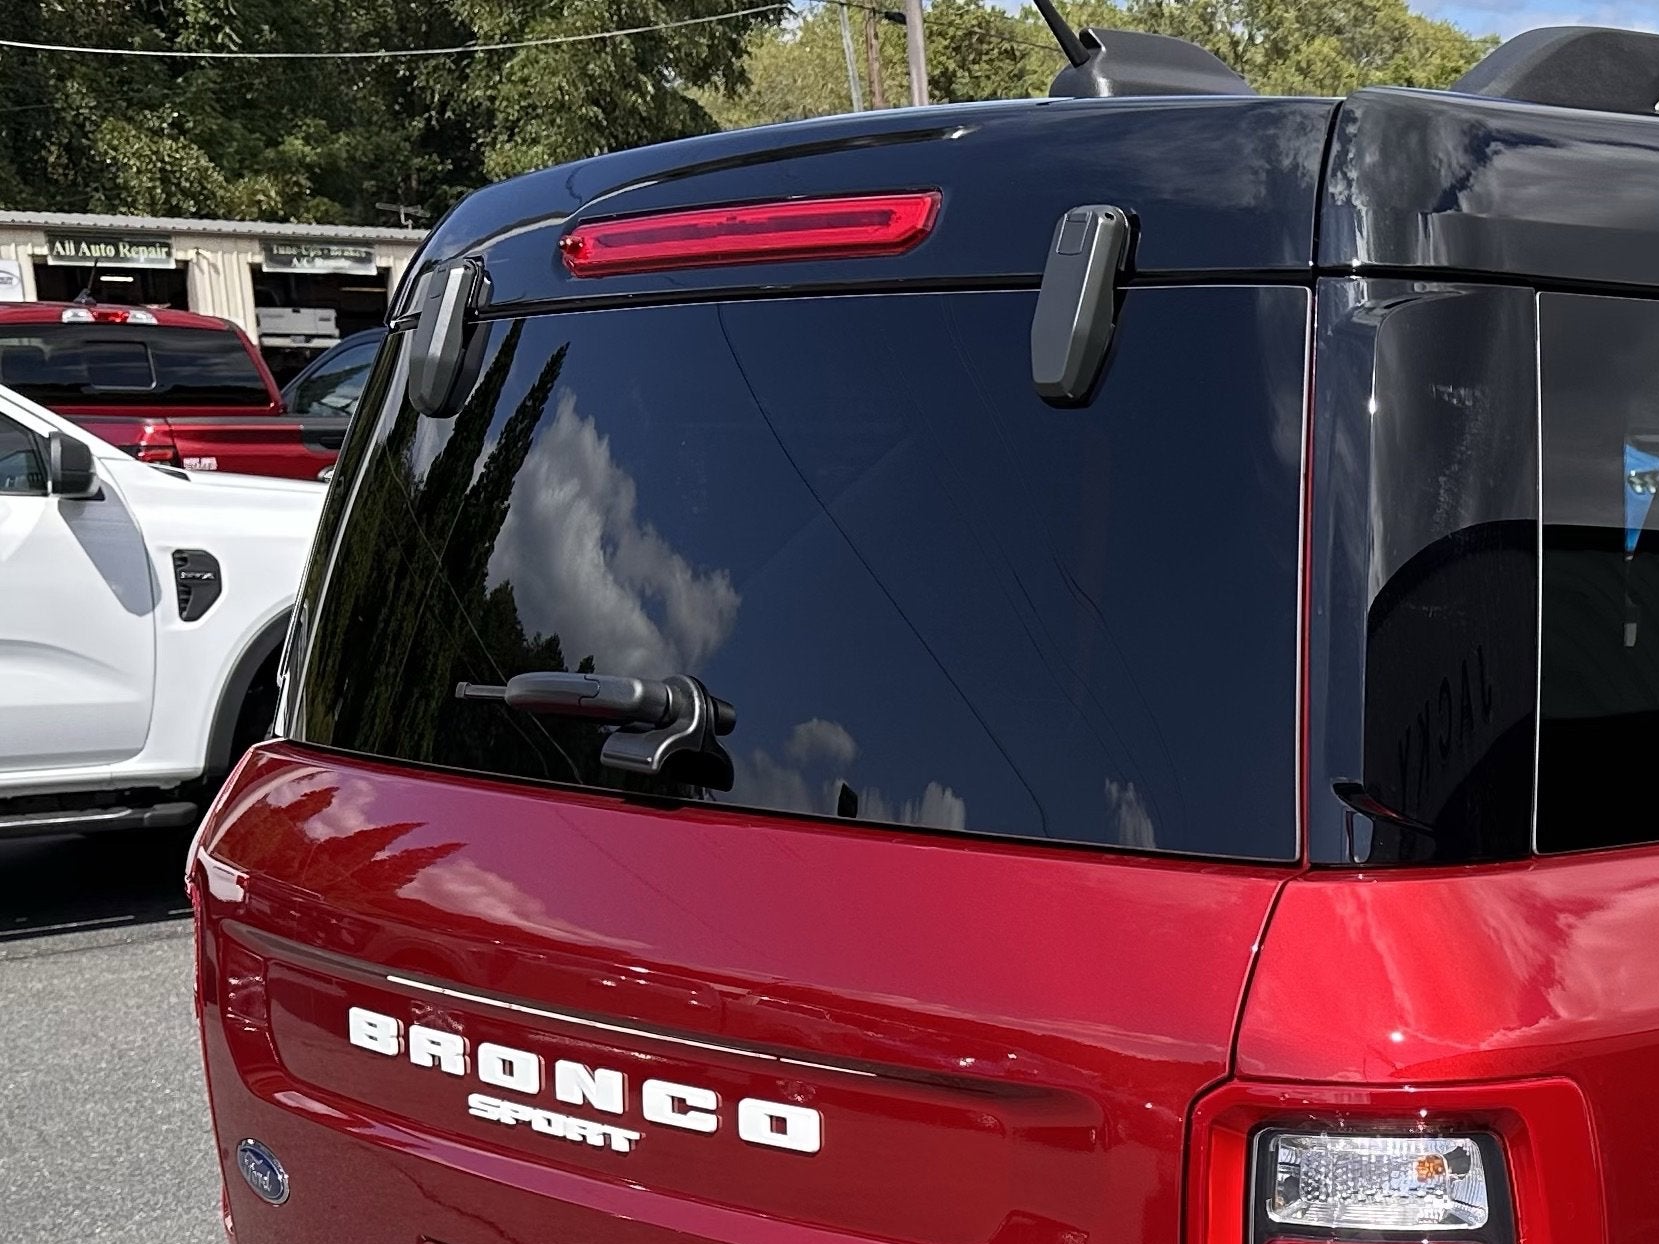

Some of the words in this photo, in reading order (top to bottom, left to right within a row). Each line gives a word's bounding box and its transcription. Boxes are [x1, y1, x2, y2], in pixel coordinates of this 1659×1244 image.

[52, 239, 76, 256] All
[78, 240, 115, 257] Auto
[118, 241, 169, 262] Repair
[348, 1006, 824, 1154] BRONCO
[467, 1092, 645, 1154] SPORT
